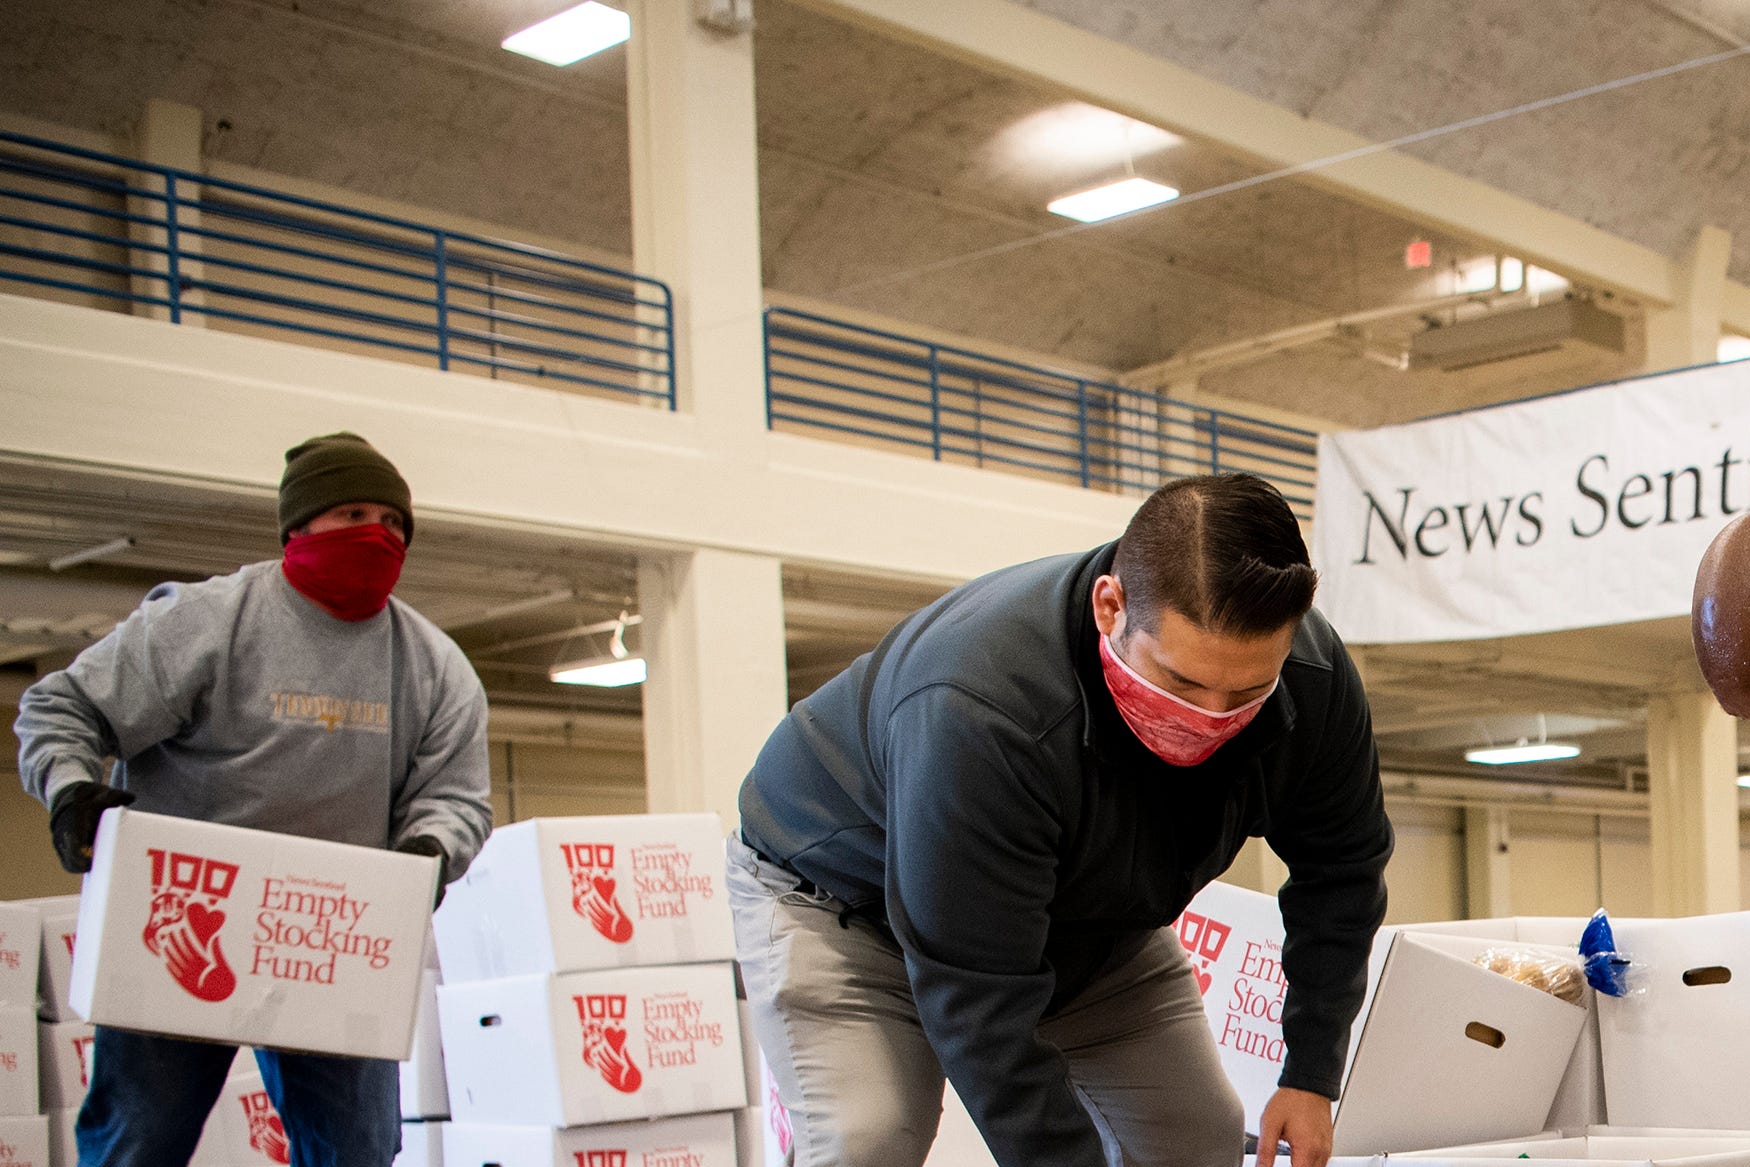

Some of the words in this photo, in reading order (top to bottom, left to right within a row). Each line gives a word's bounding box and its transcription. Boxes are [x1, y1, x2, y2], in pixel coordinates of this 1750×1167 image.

[1353, 487, 1544, 566] News
[147, 848, 240, 898] 100
[631, 849, 692, 877] Empty
[634, 873, 713, 898] Stocking
[260, 877, 370, 931] Empty
[637, 890, 687, 919] Fund
[254, 911, 392, 970] Stocking
[249, 945, 336, 985] Fund
[642, 998, 703, 1027] Empty
[644, 1022, 723, 1047] Stocking
[646, 1040, 696, 1069] Fund
